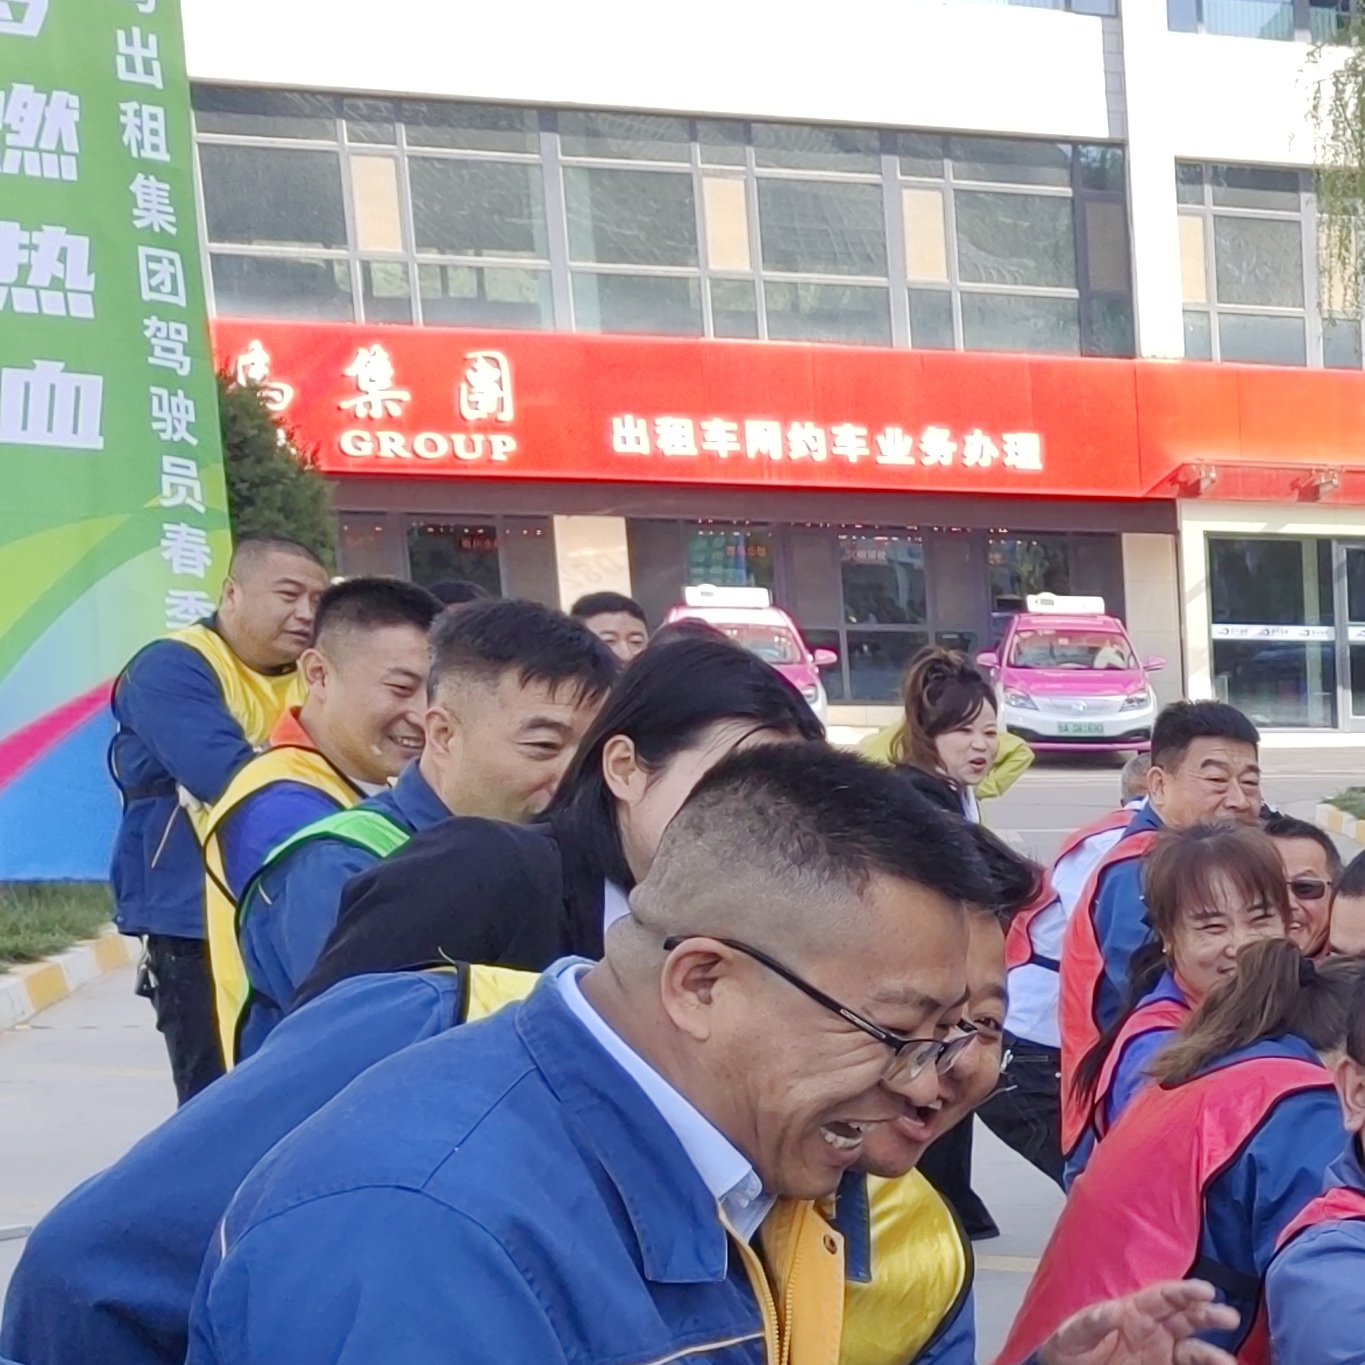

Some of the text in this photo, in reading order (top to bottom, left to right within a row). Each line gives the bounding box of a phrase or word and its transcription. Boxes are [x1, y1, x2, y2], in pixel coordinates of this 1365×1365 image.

[115, 0, 217, 629] 出租集团驾驶员春季
[339, 429, 517, 462] GROUP
[611, 413, 1043, 470] 出租车网约车业务办理
